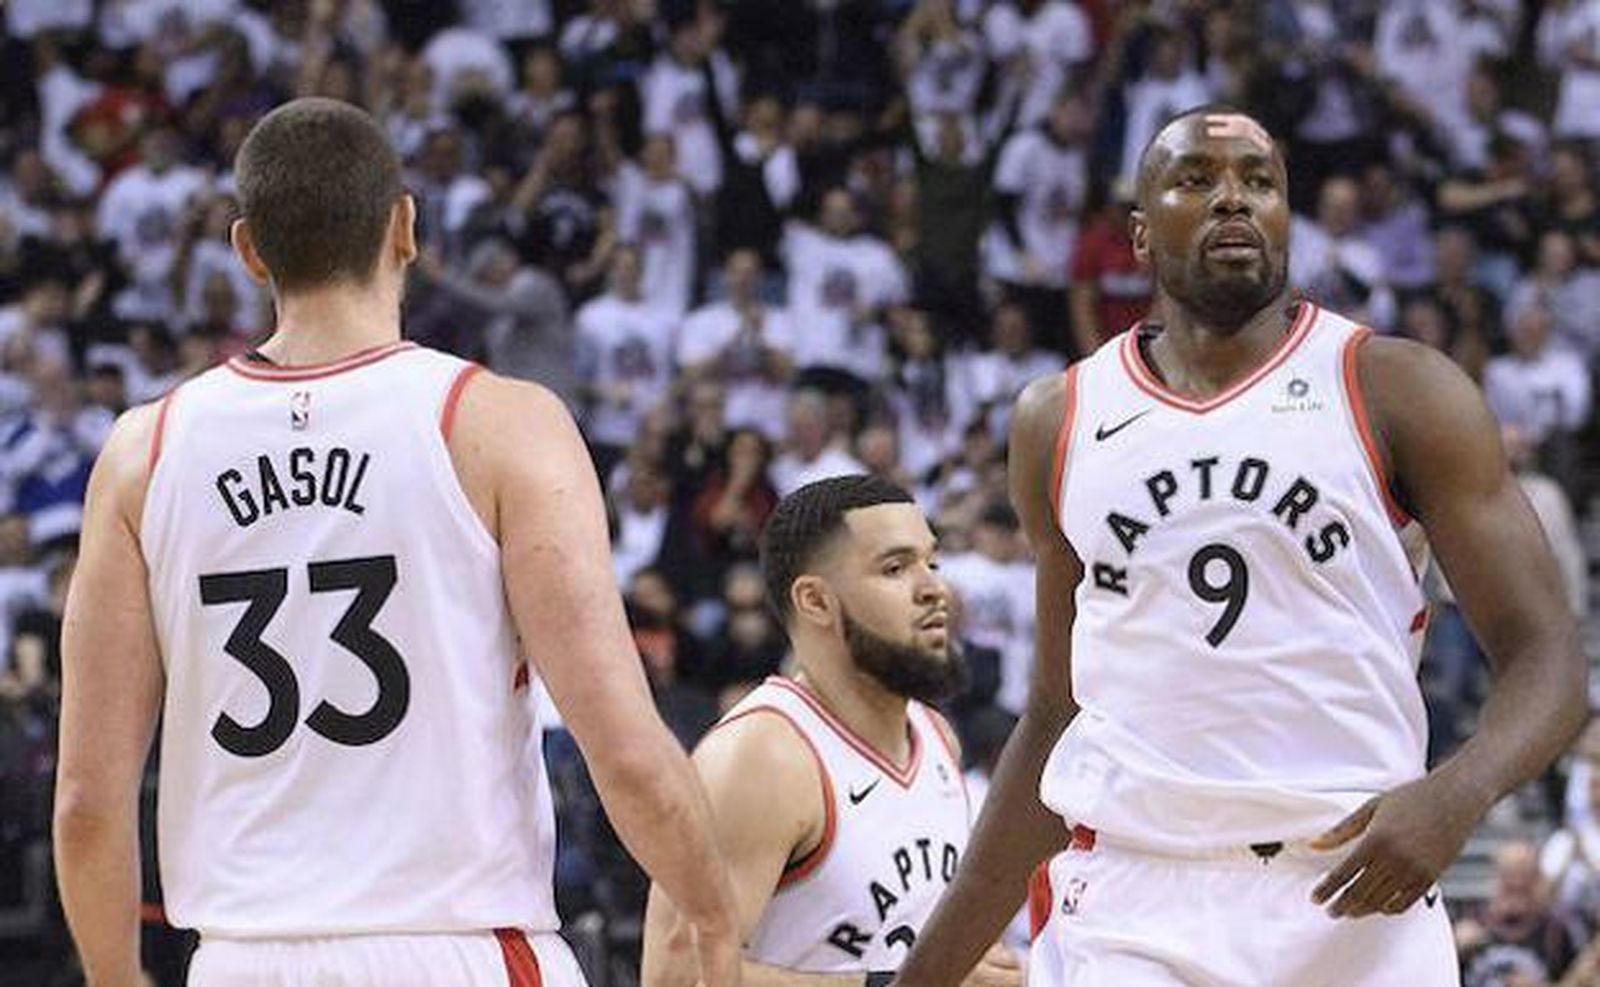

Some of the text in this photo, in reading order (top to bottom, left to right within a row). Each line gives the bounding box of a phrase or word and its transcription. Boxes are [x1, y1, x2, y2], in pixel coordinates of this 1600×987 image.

[215, 447, 371, 528] GASOL
[1091, 455, 1351, 598] RAPTORS
[198, 554, 412, 758] 33
[1187, 542, 1251, 649] 9
